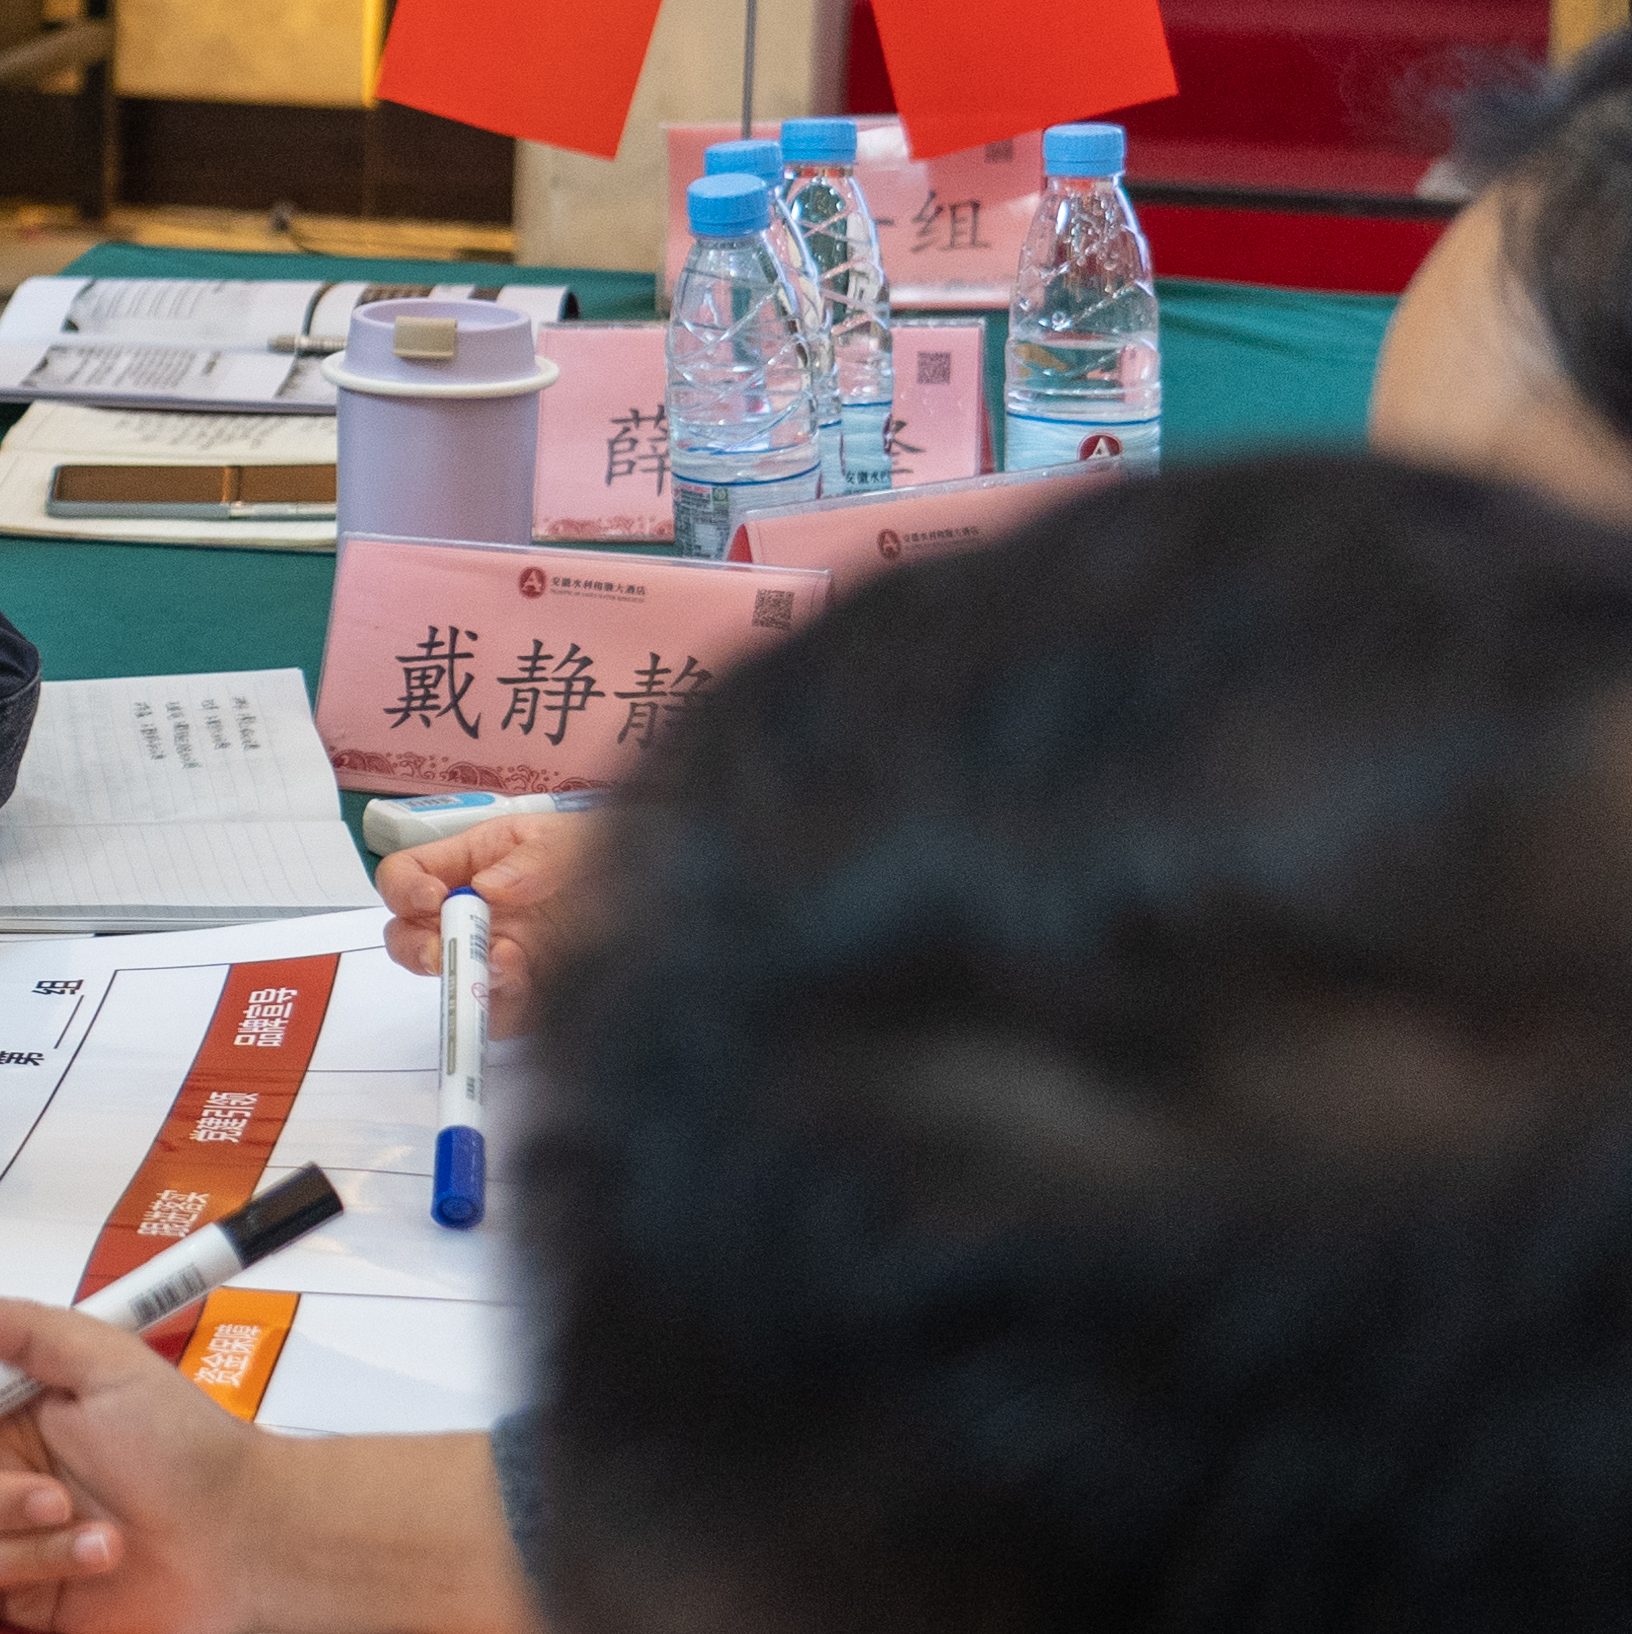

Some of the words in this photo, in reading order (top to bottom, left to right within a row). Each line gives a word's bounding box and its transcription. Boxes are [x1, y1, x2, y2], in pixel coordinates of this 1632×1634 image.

[382, 625, 714, 747] 戴静静
[233, 987, 299, 1048] 品牌宣导
[189, 1091, 259, 1144] 党建引领
[193, 1323, 262, 1389] 资金保障
